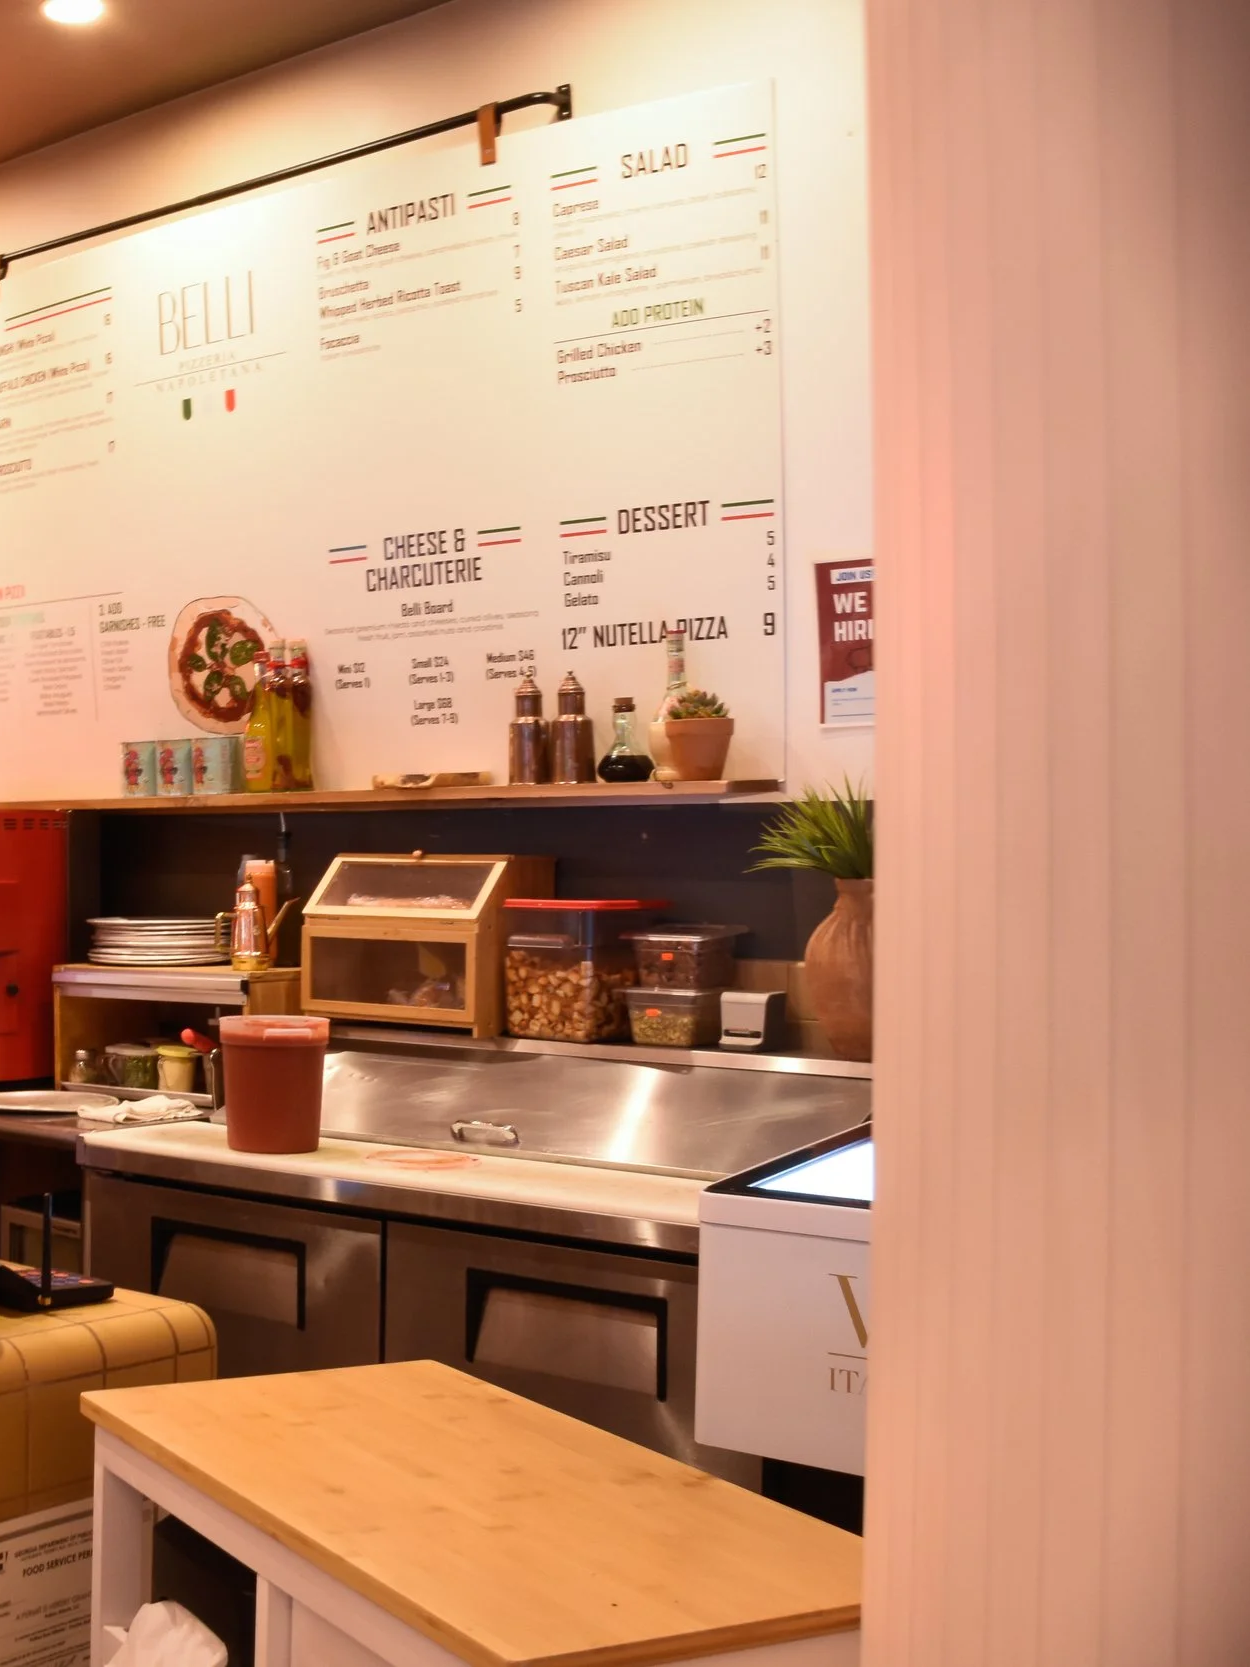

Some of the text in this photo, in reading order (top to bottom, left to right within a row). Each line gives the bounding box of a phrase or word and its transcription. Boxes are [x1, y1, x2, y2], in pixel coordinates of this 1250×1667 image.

[621, 143, 688, 179] SALAD
[755, 164, 767, 180] 12
[366, 193, 456, 235] ANTIPASTI
[553, 199, 599, 217] Caprese
[366, 243, 400, 257] Cheese
[555, 235, 629, 260] Caesar Salad
[555, 276, 594, 295] Tuscan
[598, 272, 621, 288] Kale
[625, 265, 658, 282] Salad
[359, 294, 393, 310] Herbed
[397, 287, 430, 302] Ricotta
[434, 281, 461, 296] Toast
[158, 270, 253, 355] BELLI
[515, 299, 522, 312] 5
[611, 298, 705, 328] ADD PROTEIN
[557, 340, 642, 364] Grilled Chicken
[755, 340, 772, 356] +3
[558, 366, 617, 385] Prosciutto
[617, 500, 710, 535] DESSERT
[383, 528, 466, 561] CHEESE &
[767, 530, 775, 546] 5
[563, 549, 611, 565] Tiramisu
[767, 553, 775, 568] 4
[366, 557, 483, 593] CHARCUTERIE
[563, 569, 604, 587] Cannoli
[767, 575, 776, 591] 5
[401, 599, 454, 617] Belli Board
[564, 592, 599, 607] Gelato
[833, 592, 868, 614] WE
[593, 619, 668, 648] NUTELLA
[676, 616, 728, 642] PIZZA
[763, 612, 776, 636] 9
[833, 619, 874, 642] HIRI
[411, 658, 432, 670] Small
[486, 651, 516, 664] Medium
[337, 663, 352, 675] Mini
[485, 667, 517, 681] (Serves
[335, 679, 362, 691] (Serves
[409, 672, 438, 686] (Serves
[413, 698, 435, 712] Large
[411, 713, 441, 727] (Serves
[22, 1548, 93, 1578] FOOD SERVICE PER
